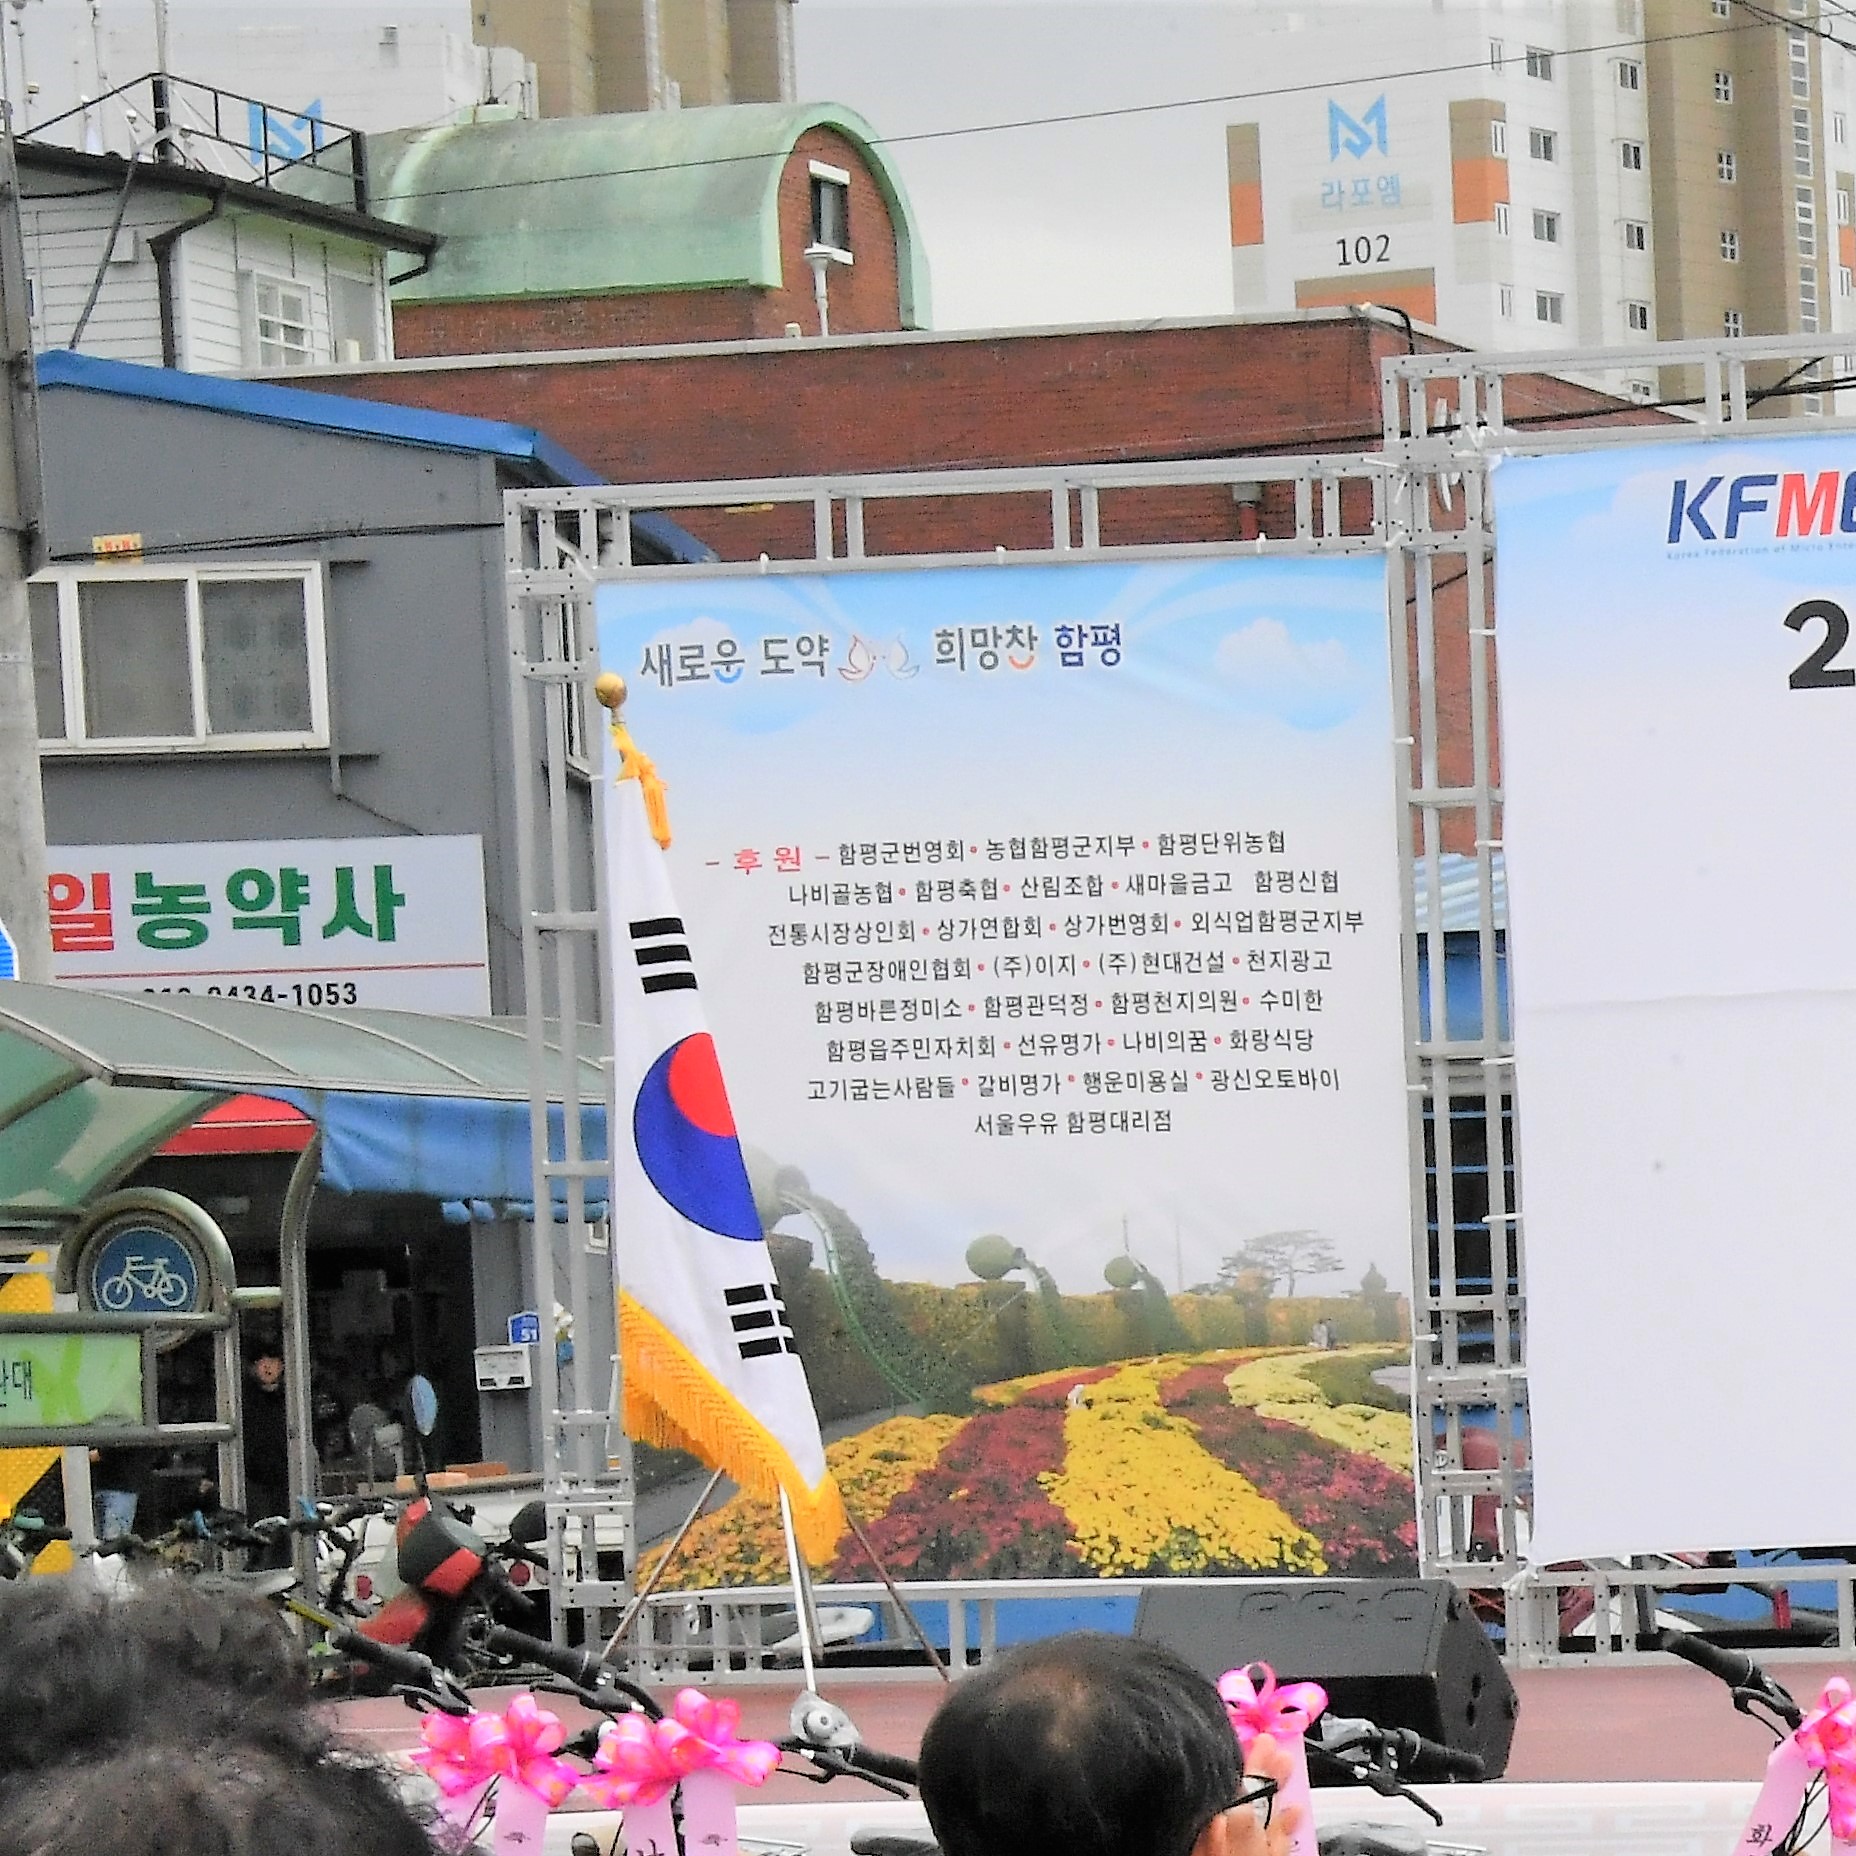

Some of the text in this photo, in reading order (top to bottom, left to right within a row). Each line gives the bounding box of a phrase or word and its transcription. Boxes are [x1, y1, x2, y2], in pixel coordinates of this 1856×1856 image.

[1336, 234, 1391, 266] 102
[641, 623, 1121, 687] 새로운 도약 희망찬 함평
[839, 839, 964, 867] 함평군번영회
[985, 834, 1136, 861] 농협함평군지부
[1158, 830, 1285, 857] 함평단위농협
[788, 869, 1339, 906] 나비골농협 함평축협 산림조합 새마을금고 함평신협
[768, 909, 1364, 947] 전통시장상인회 상가연합회 상가번영회 외식업함평군지부
[803, 948, 1333, 985] 함평군장애인협회 (주)이지 (주)현대건설 천지광고
[815, 988, 1323, 1024] 함평바른정미소 함평관덕정 함평천지의원 수미한
[826, 1028, 1314, 1063] 함평읍주민자치회 선유명가 나비의꿈 화랑식당
[807, 1068, 1341, 1101] 고기굽는사람들 갈비명가 행운미용실 광신오토바이
[974, 1109, 1172, 1137] 서울우유 함평대리점
